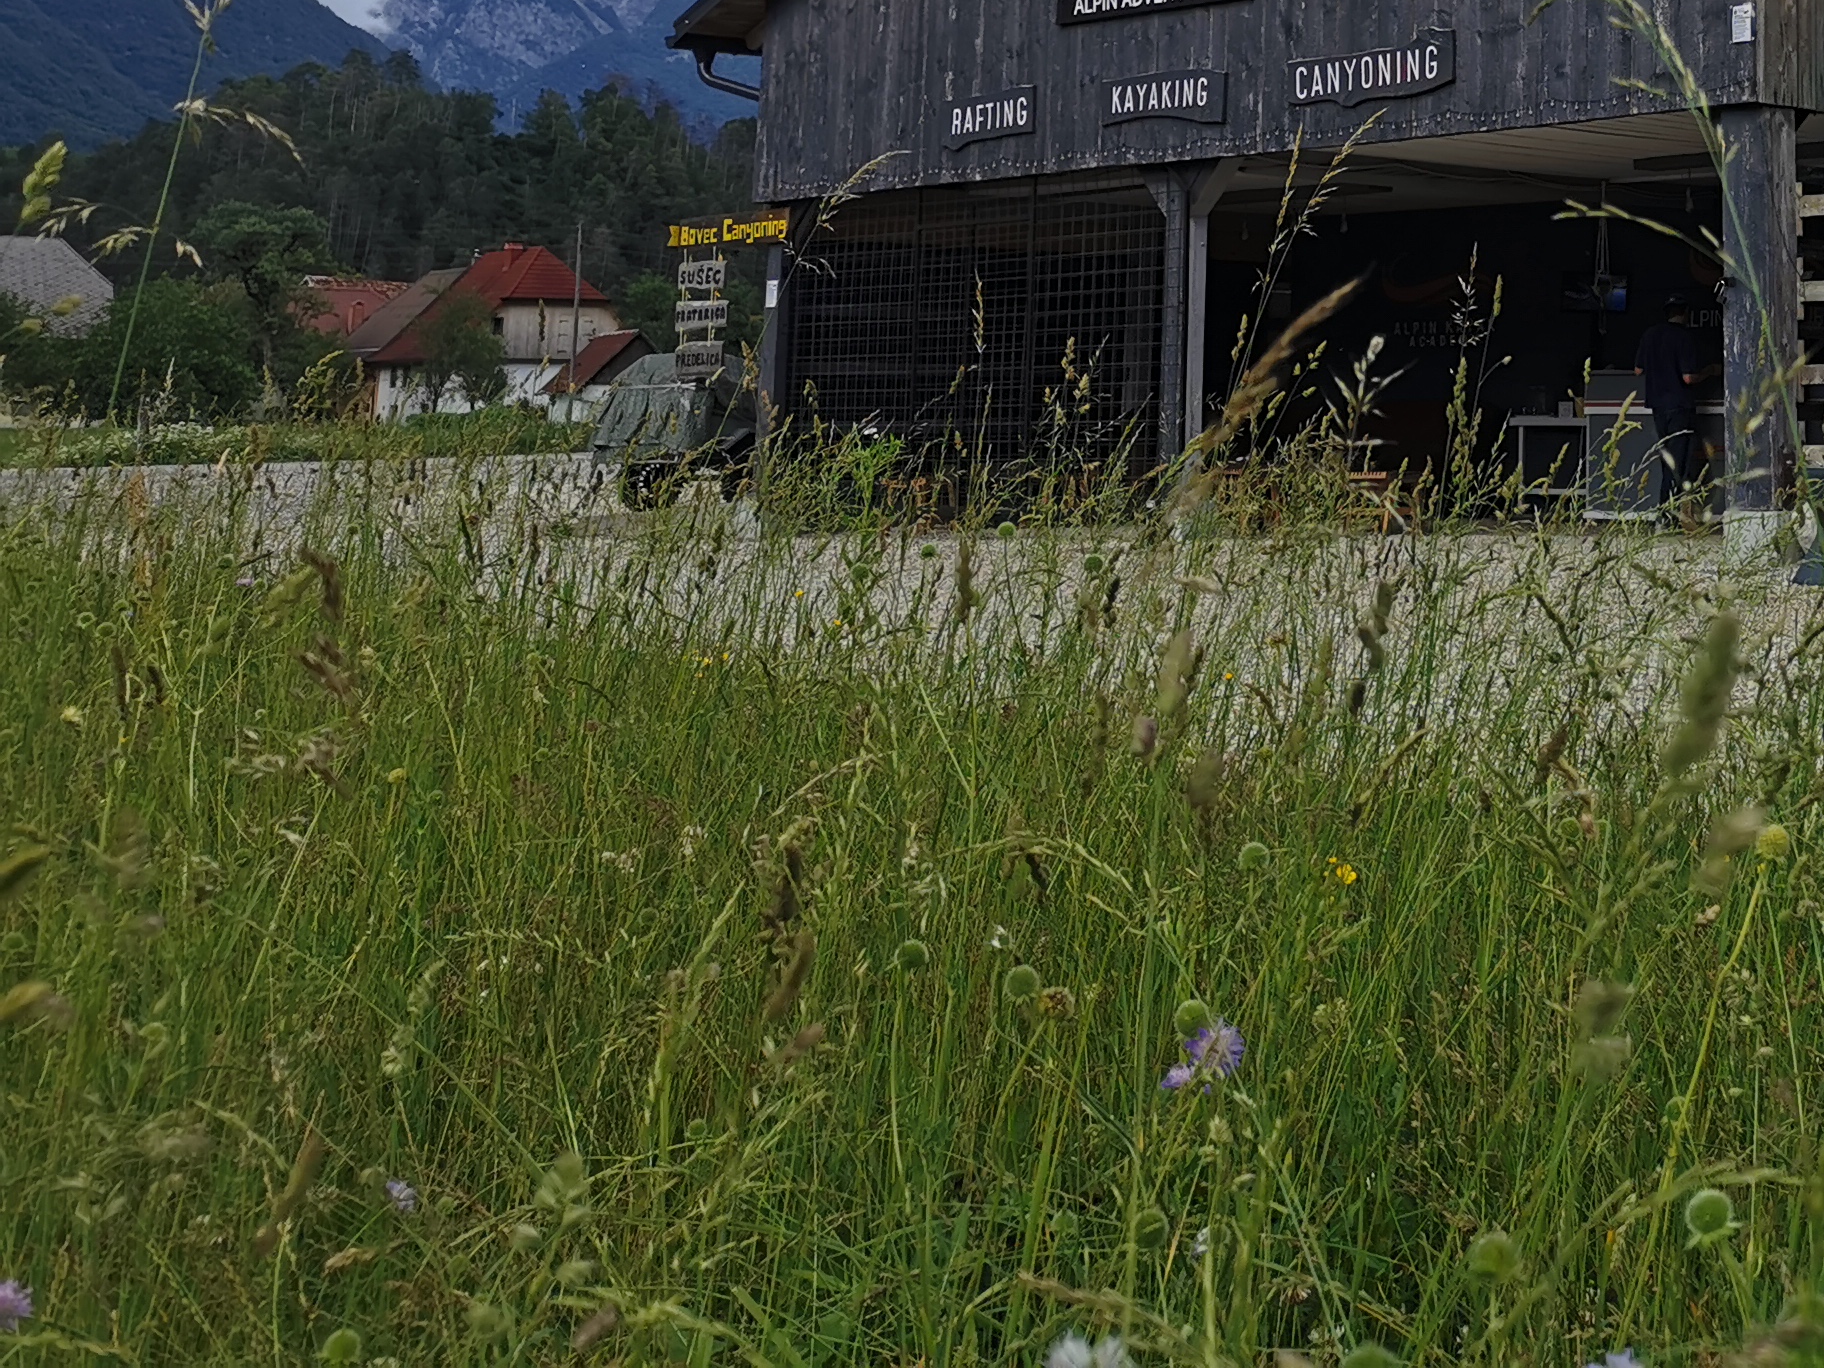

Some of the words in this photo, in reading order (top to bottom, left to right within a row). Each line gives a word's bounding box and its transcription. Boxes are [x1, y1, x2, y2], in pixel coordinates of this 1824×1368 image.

[1294, 44, 1439, 100] CANYONING
[1110, 76, 1209, 115] KAYAKING
[950, 96, 1028, 136] RAFTING
[680, 225, 718, 246] Bovec
[722, 214, 788, 244] Canyoning
[1685, 309, 1722, 328] LPIN
